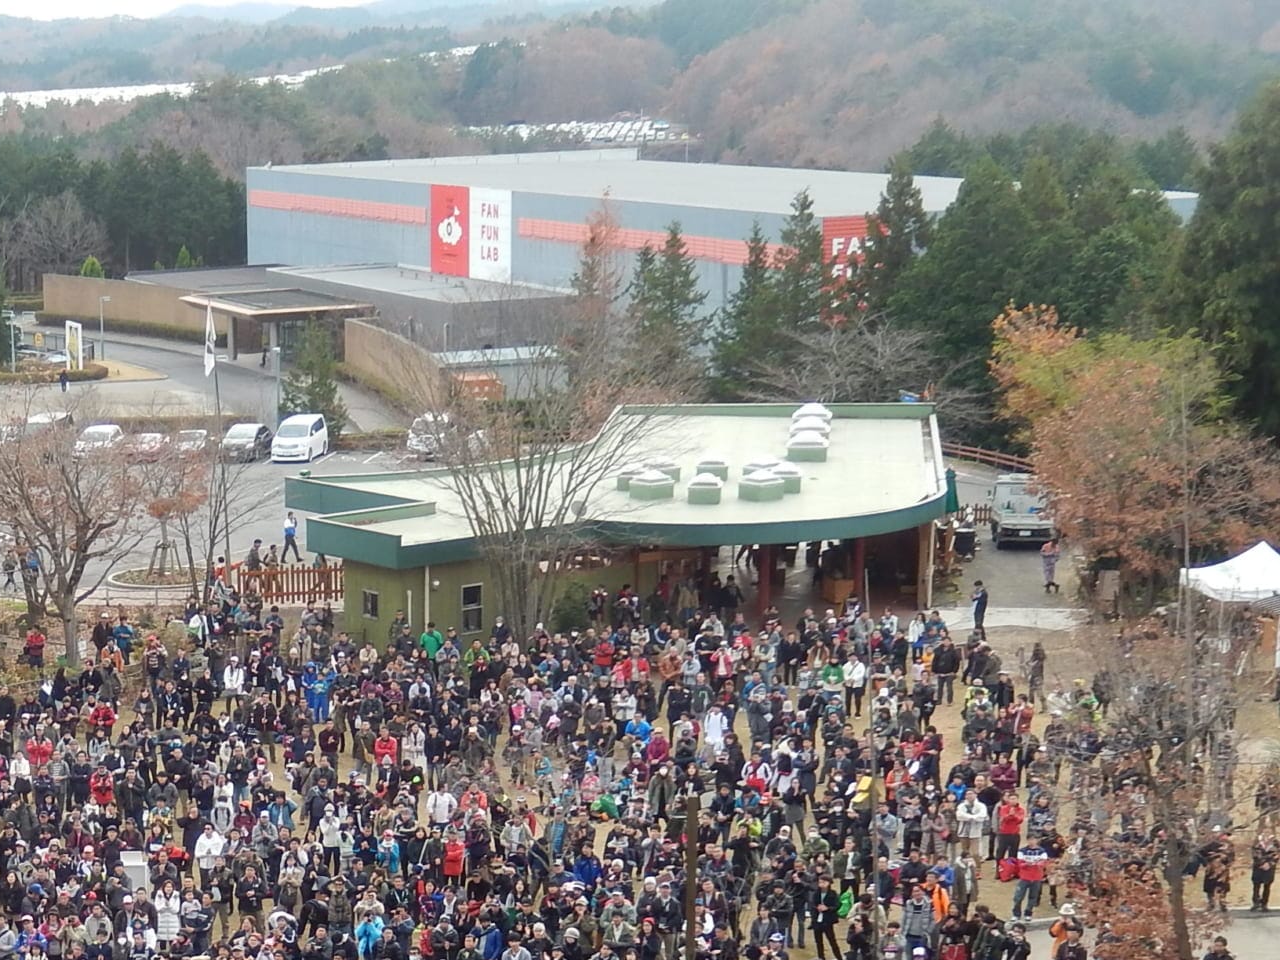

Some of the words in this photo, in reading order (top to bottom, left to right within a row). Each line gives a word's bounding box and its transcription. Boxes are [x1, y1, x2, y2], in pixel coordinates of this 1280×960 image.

[481, 203, 499, 219] FAN
[481, 225, 499, 241] FUN
[481, 246, 499, 262] LAB
